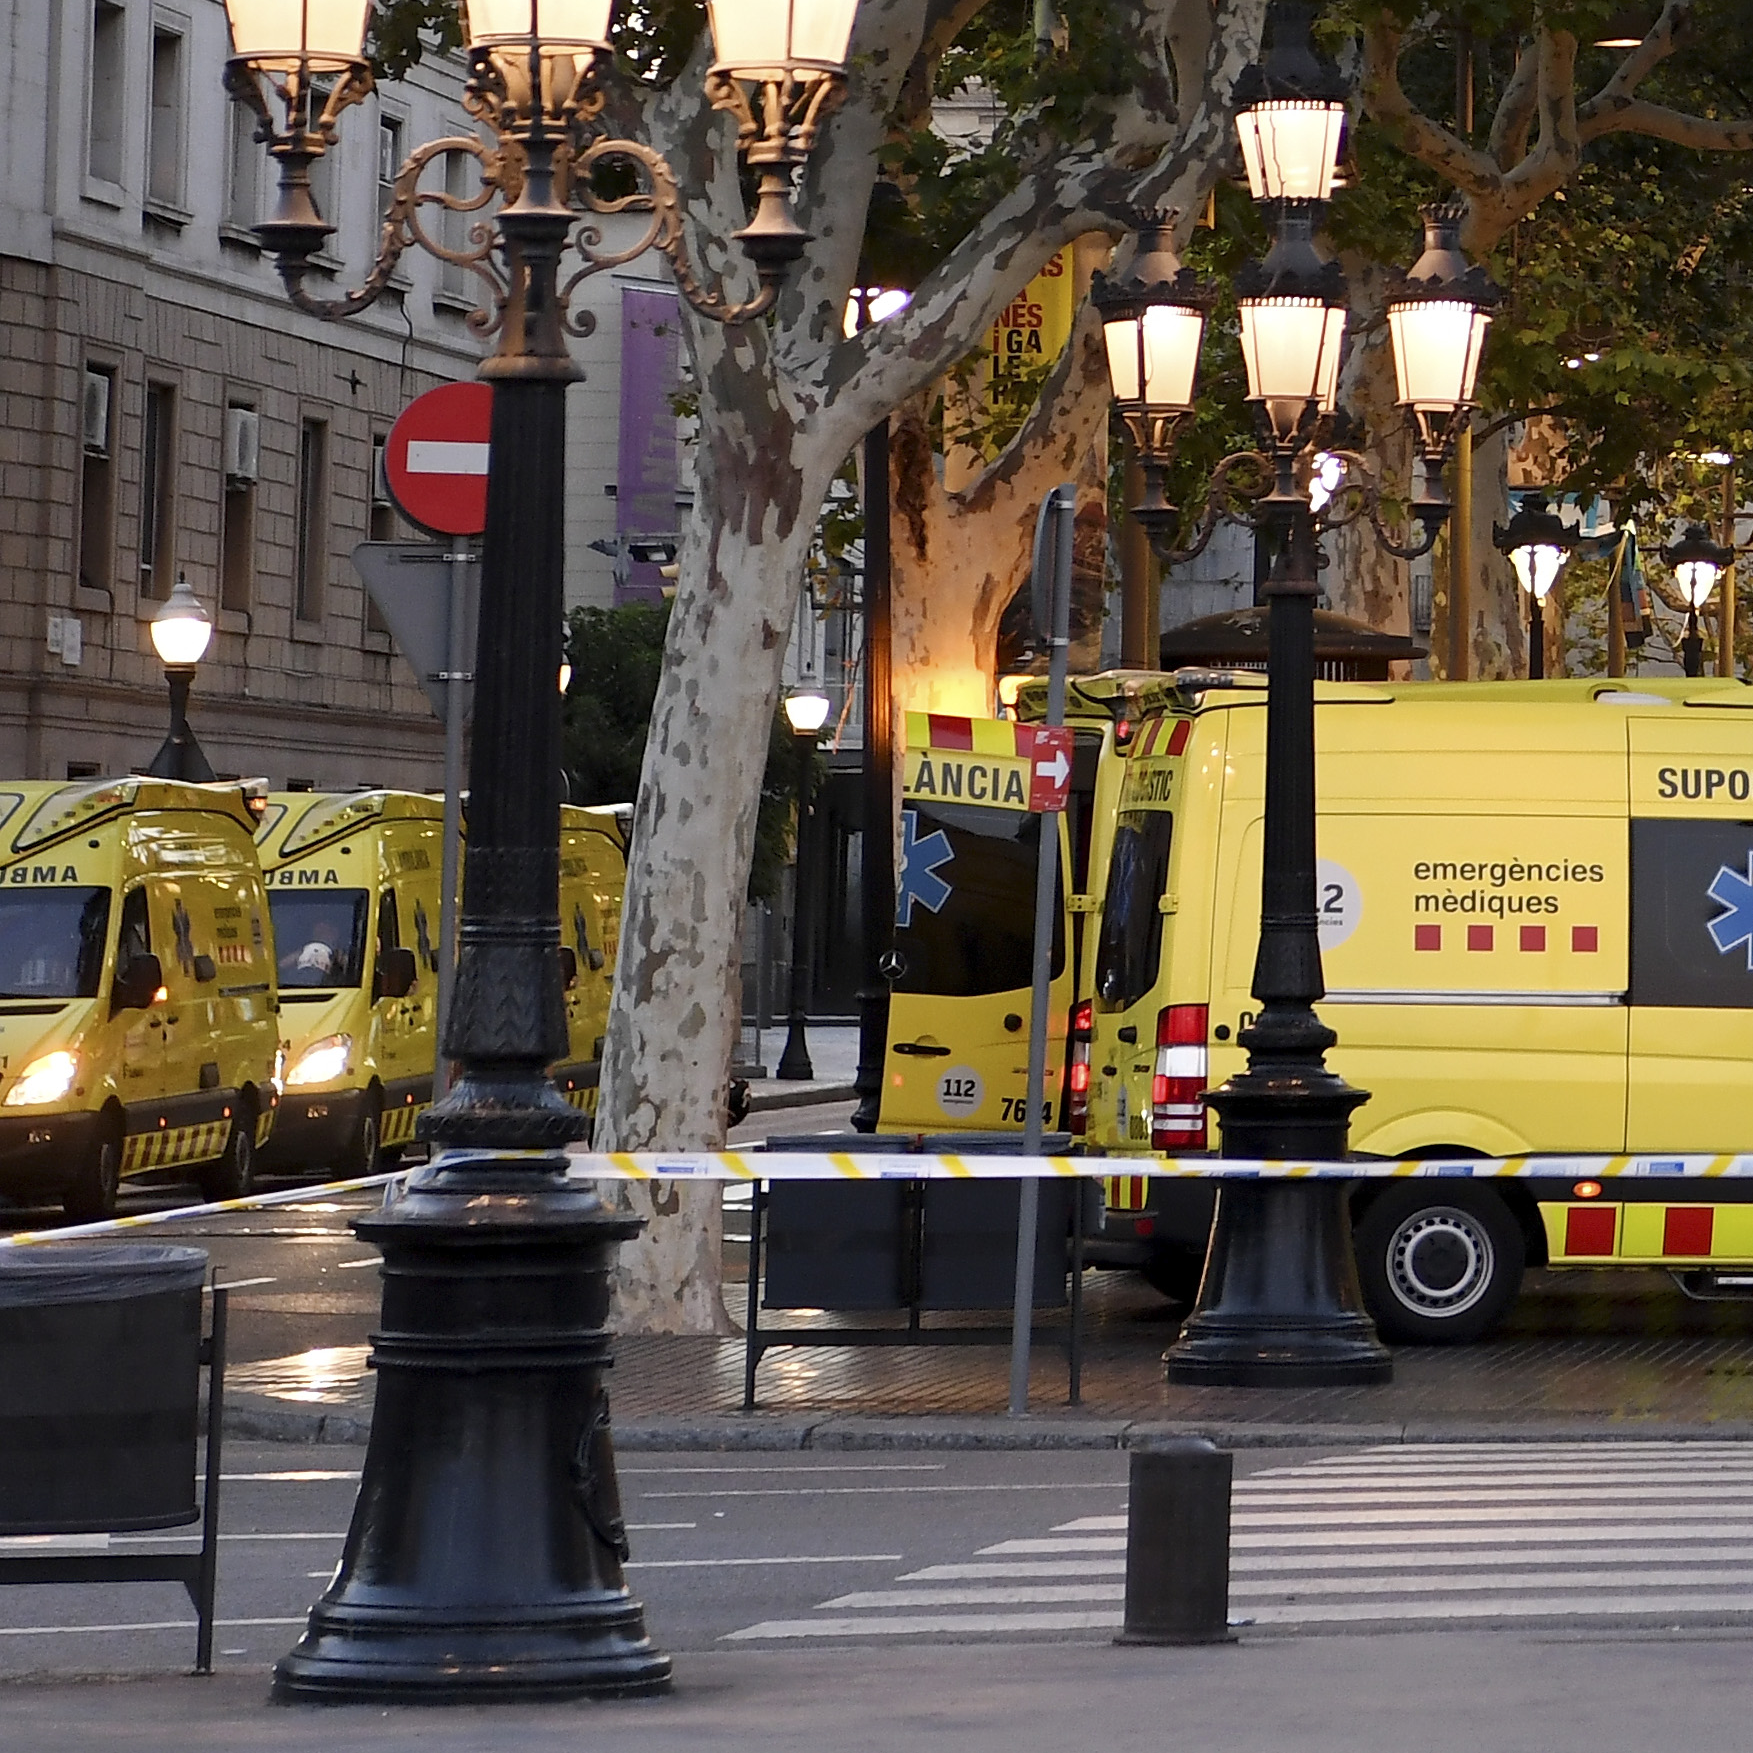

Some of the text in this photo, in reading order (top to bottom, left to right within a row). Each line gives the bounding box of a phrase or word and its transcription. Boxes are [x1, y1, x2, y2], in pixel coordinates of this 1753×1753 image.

[1007, 329, 1042, 353] GA
[902, 751, 1025, 805] ÀNCIA
[1413, 857, 1605, 887] emergències
[1316, 883, 1344, 913] 2
[1414, 888, 1559, 920] mèdiques
[943, 1079, 976, 1097] 112
[1001, 1097, 1053, 1125] 764
